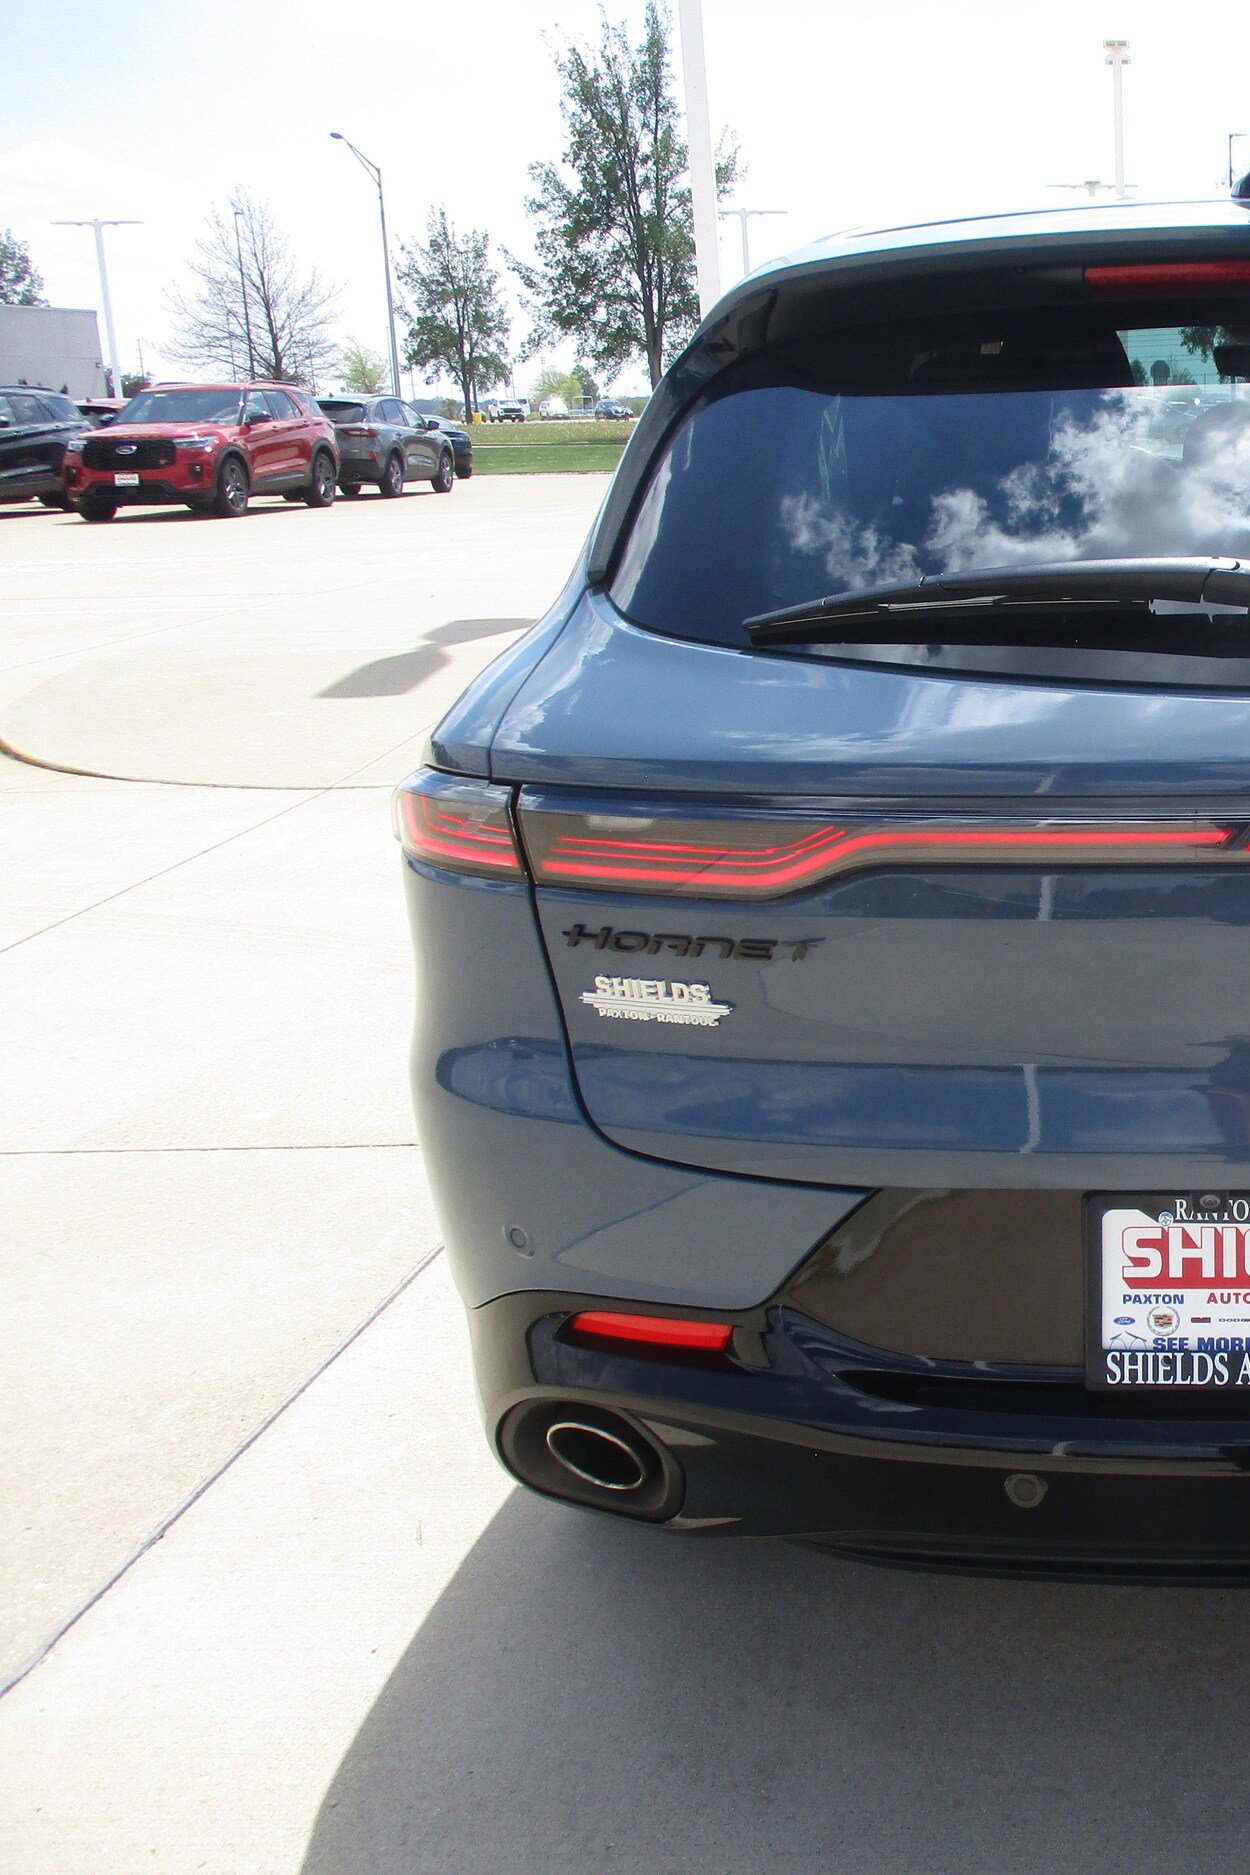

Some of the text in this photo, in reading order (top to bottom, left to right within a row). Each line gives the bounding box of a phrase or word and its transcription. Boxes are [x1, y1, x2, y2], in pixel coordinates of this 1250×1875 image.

[561, 923, 826, 962] HORNET
[594, 975, 712, 1004] SHIELDS
[1122, 1293, 1185, 1305] PAXTON
[1152, 1337, 1189, 1350] SEE
[1106, 1353, 1229, 1386] SHIELDS
